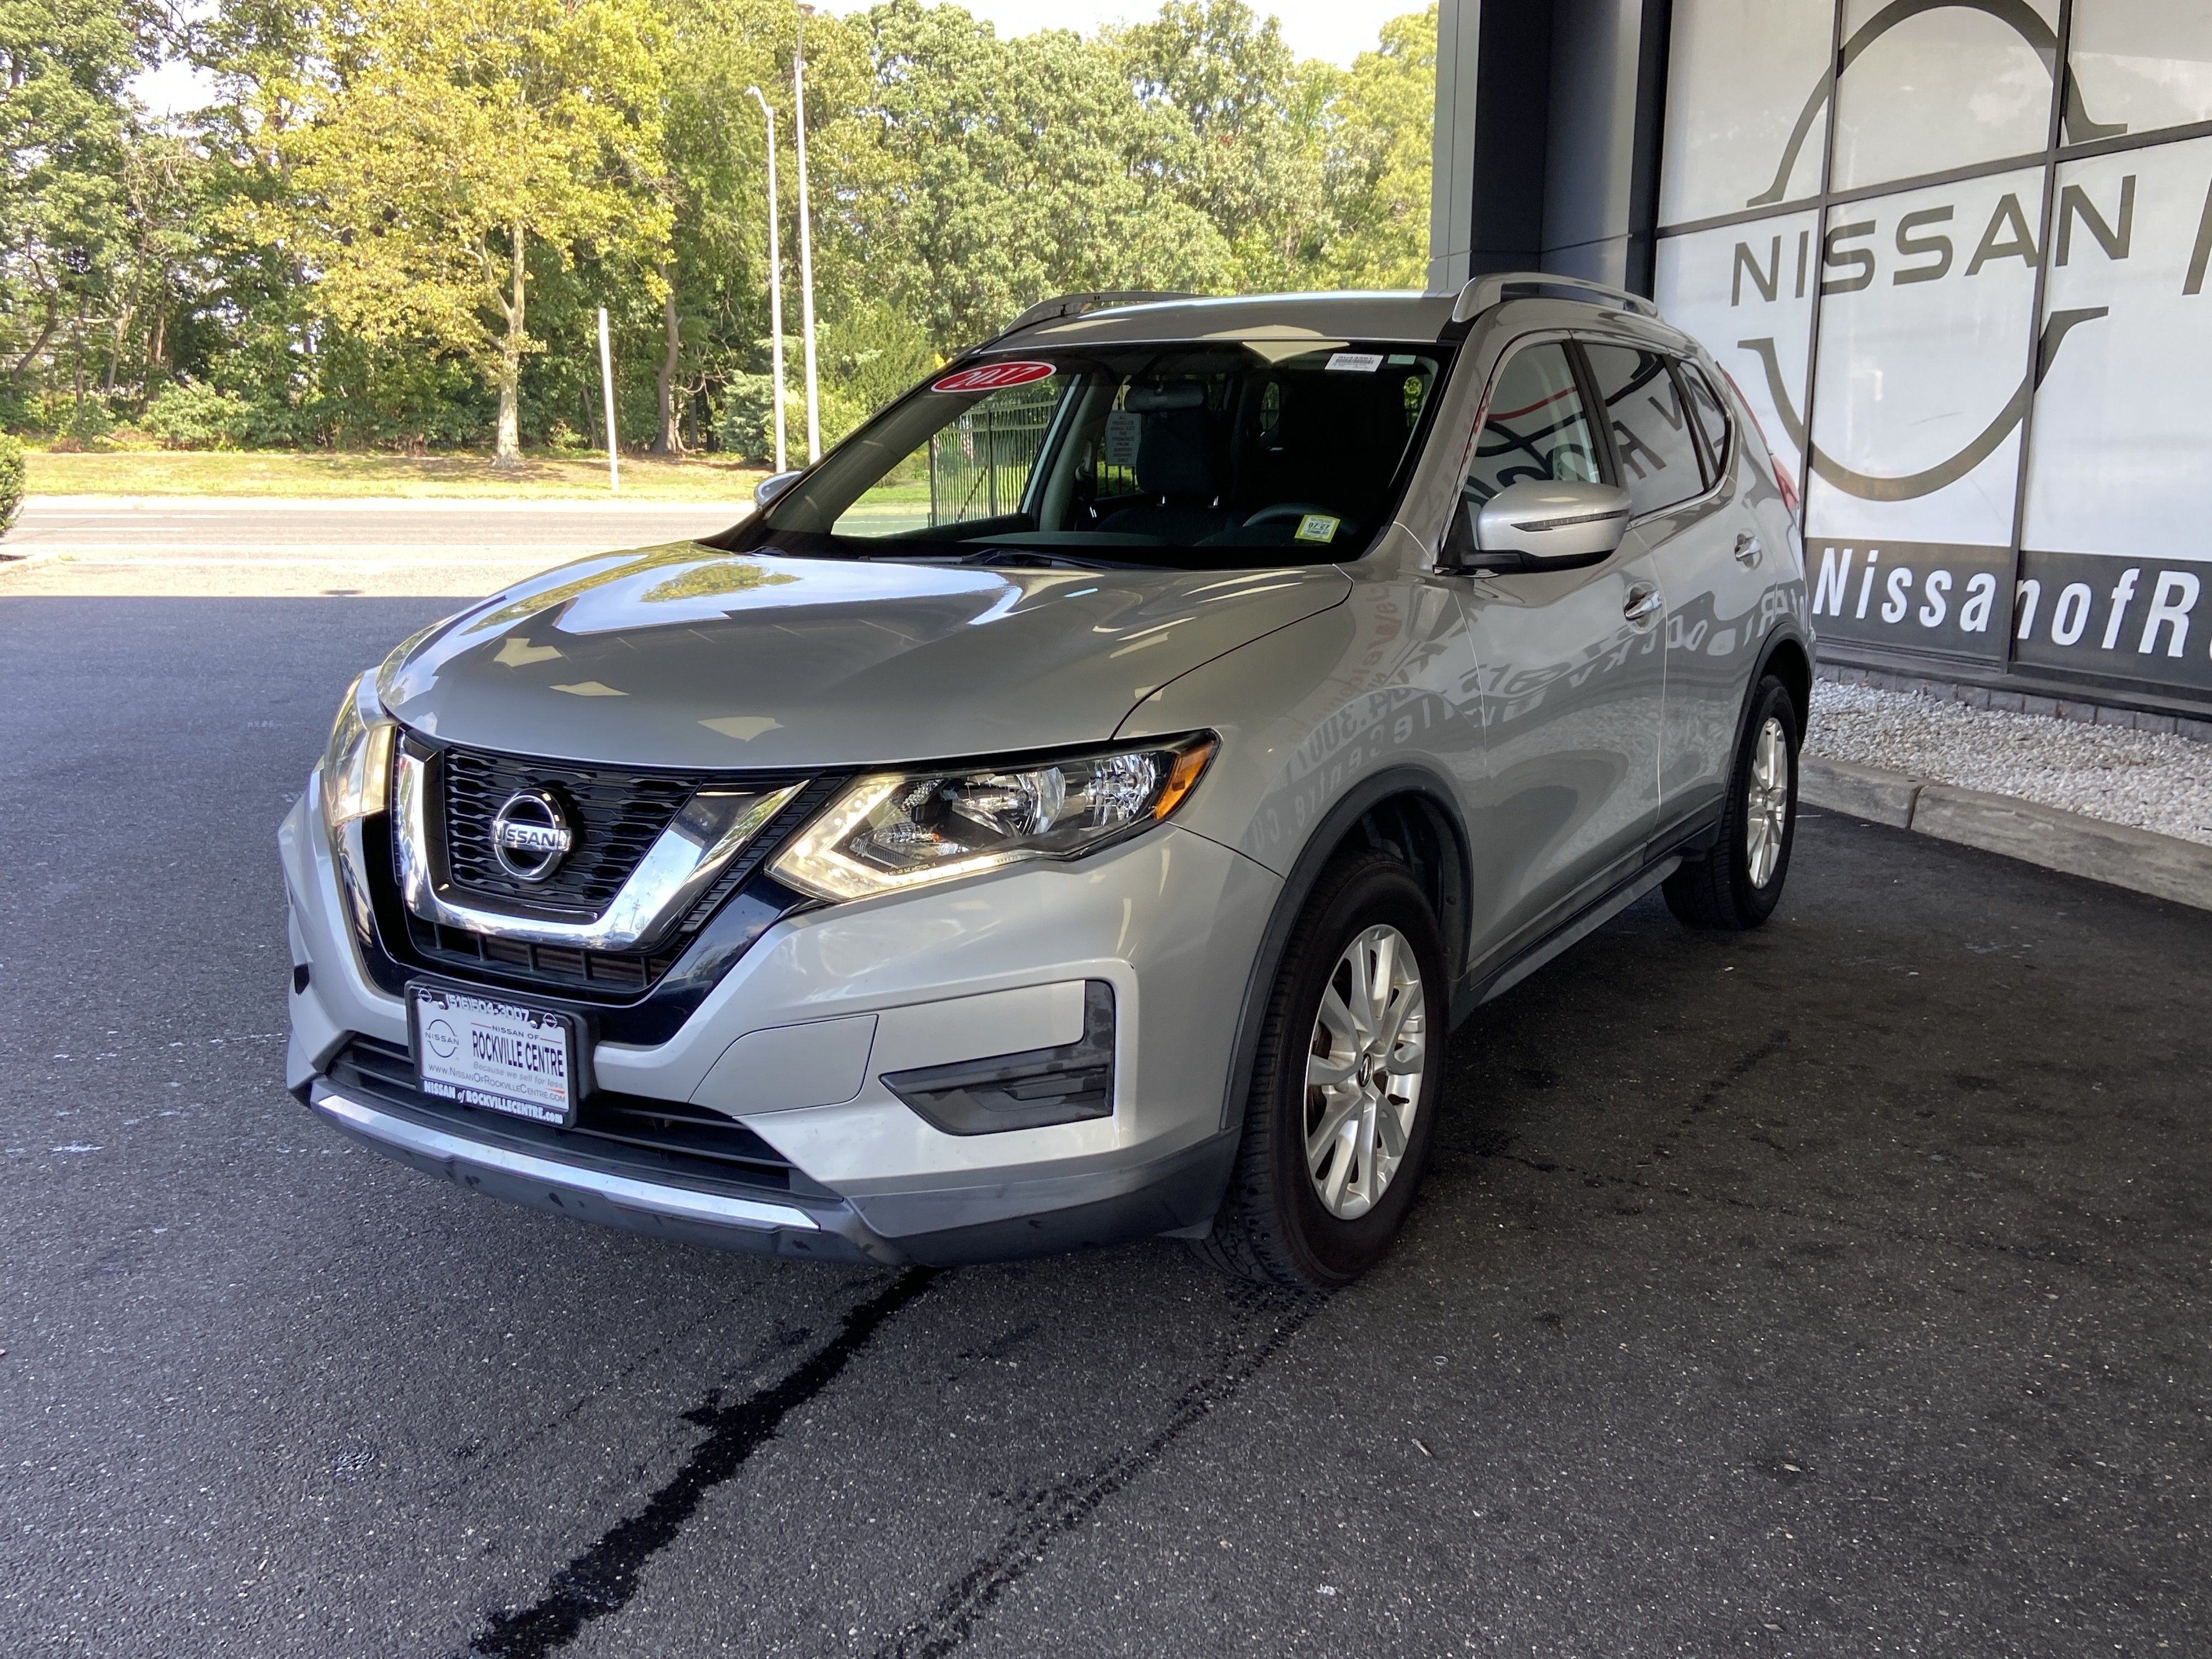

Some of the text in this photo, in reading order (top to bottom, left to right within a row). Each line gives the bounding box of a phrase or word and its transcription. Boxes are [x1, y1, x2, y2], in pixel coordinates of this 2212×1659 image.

[1730, 174, 2136, 307] NISSAN
[942, 365, 1045, 389] 2017
[1812, 547, 2212, 661] NissanofR
[495, 826, 557, 847] NISSAN
[425, 1032, 459, 1046] NISSAN
[492, 1025, 524, 1037] NISSAN
[472, 1030, 565, 1077] ROCKVILLE CENTRE
[473, 1061, 504, 1076] Because
[519, 1074, 533, 1082] sell
[534, 1075, 545, 1085] for
[547, 1078, 565, 1090] less.
[424, 1080, 456, 1099] NISSAN
[457, 1088, 465, 1104] of
